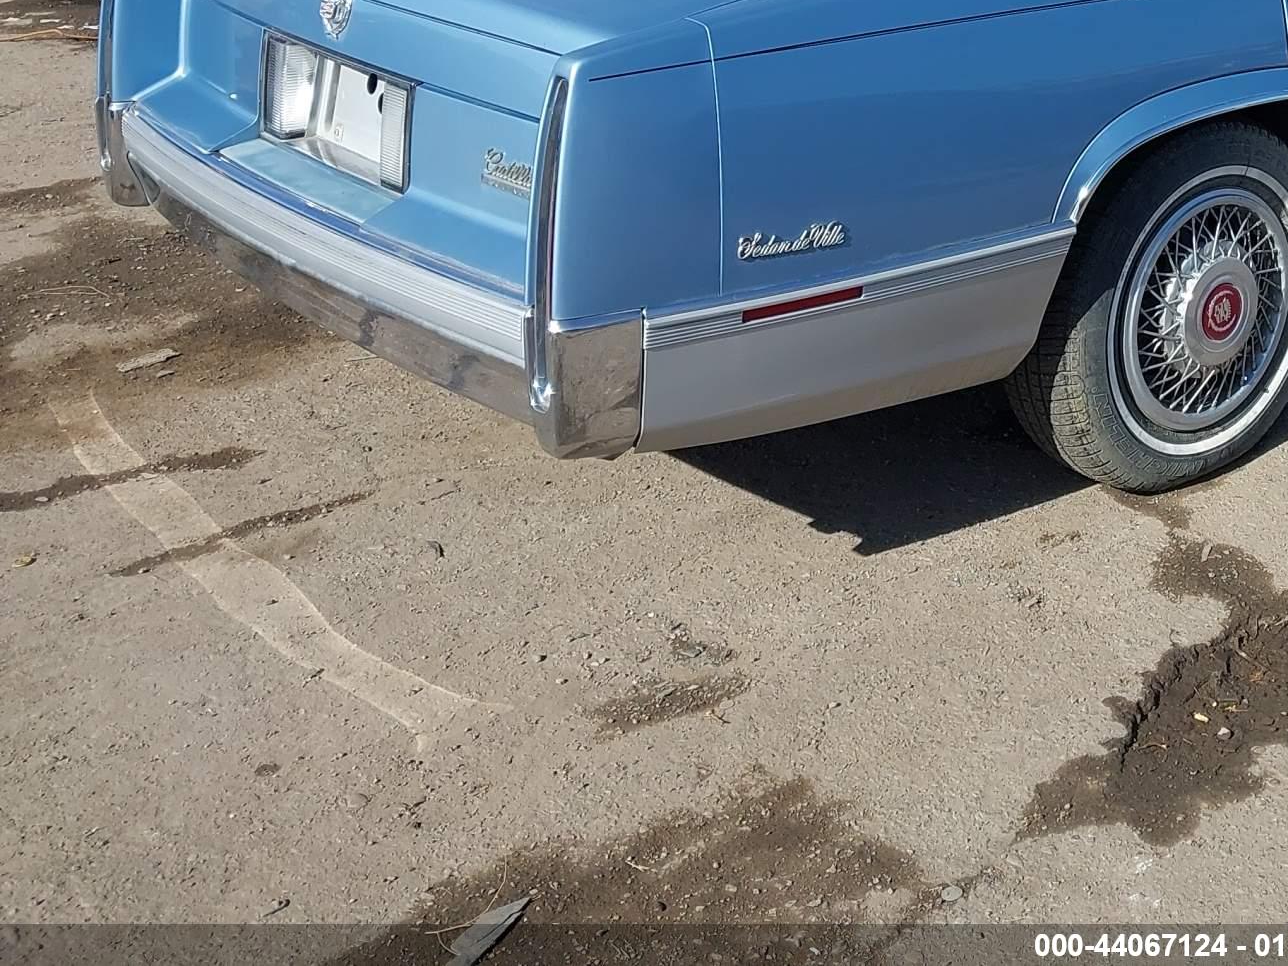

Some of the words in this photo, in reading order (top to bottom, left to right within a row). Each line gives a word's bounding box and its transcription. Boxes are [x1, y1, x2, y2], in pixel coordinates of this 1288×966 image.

[738, 232, 792, 259] Sedan
[792, 230, 810, 252] de
[809, 220, 845, 248] Ville
